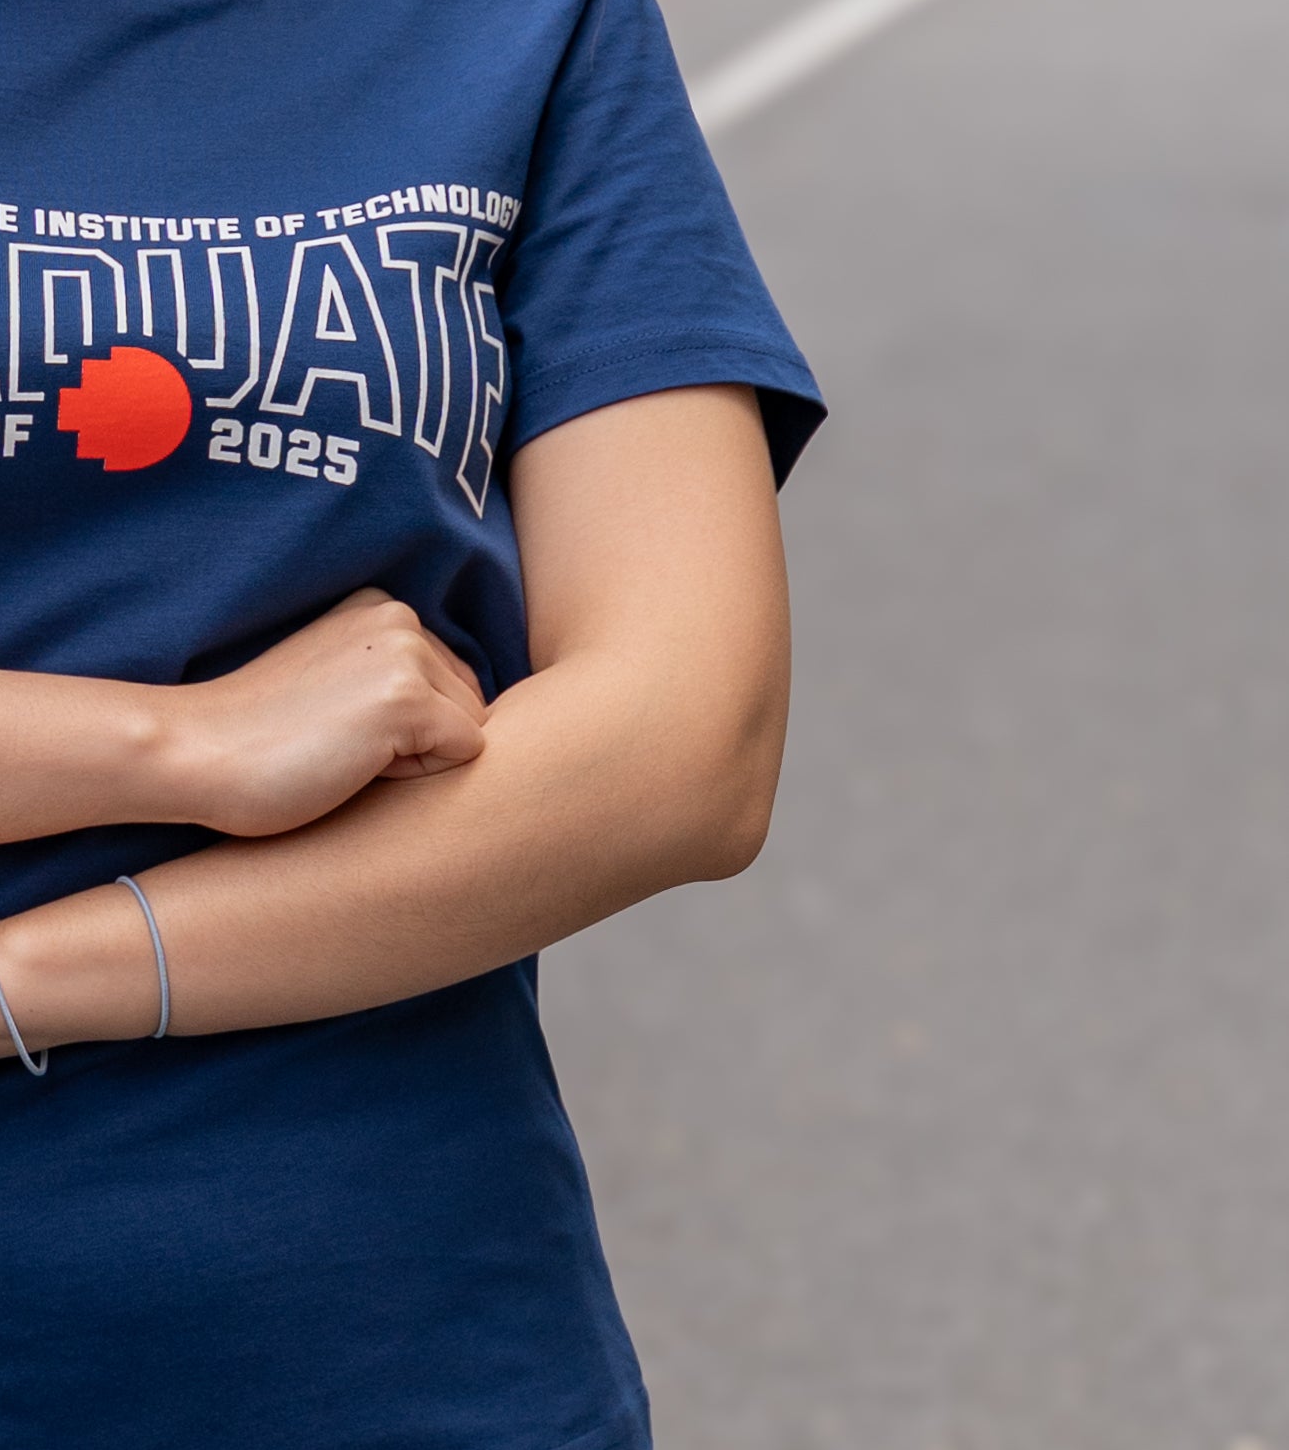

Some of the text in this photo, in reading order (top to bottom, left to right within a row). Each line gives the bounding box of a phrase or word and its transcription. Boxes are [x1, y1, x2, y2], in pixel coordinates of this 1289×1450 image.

[33, 208, 242, 242] INSTITUTE
[254, 213, 306, 238] OF
[315, 183, 522, 231] TECHNOLOGY
[208, 418, 360, 486] 2025
